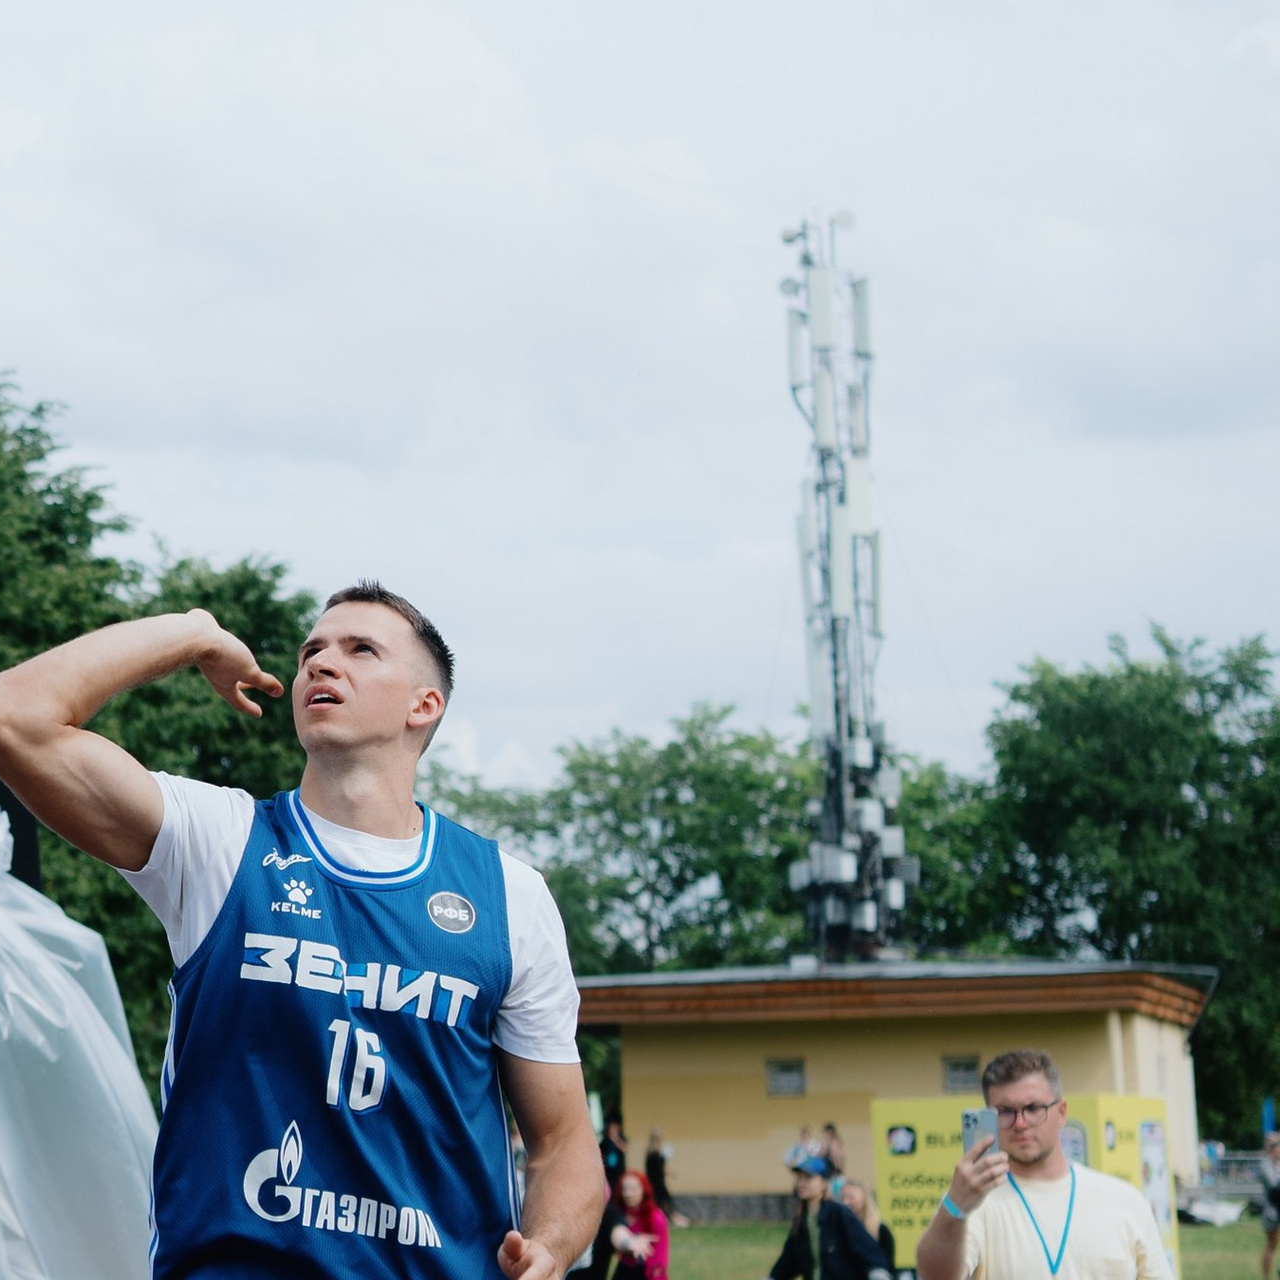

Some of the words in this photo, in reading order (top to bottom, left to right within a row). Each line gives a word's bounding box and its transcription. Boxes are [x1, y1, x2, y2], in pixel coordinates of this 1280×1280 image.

[271, 901, 321, 919] KELME
[433, 905, 469, 921] РФБ
[240, 932, 479, 1027] ЗЕНИТ
[326, 1019, 385, 1111] 16
[302, 1187, 442, 1248] ГАЗПРОМ
